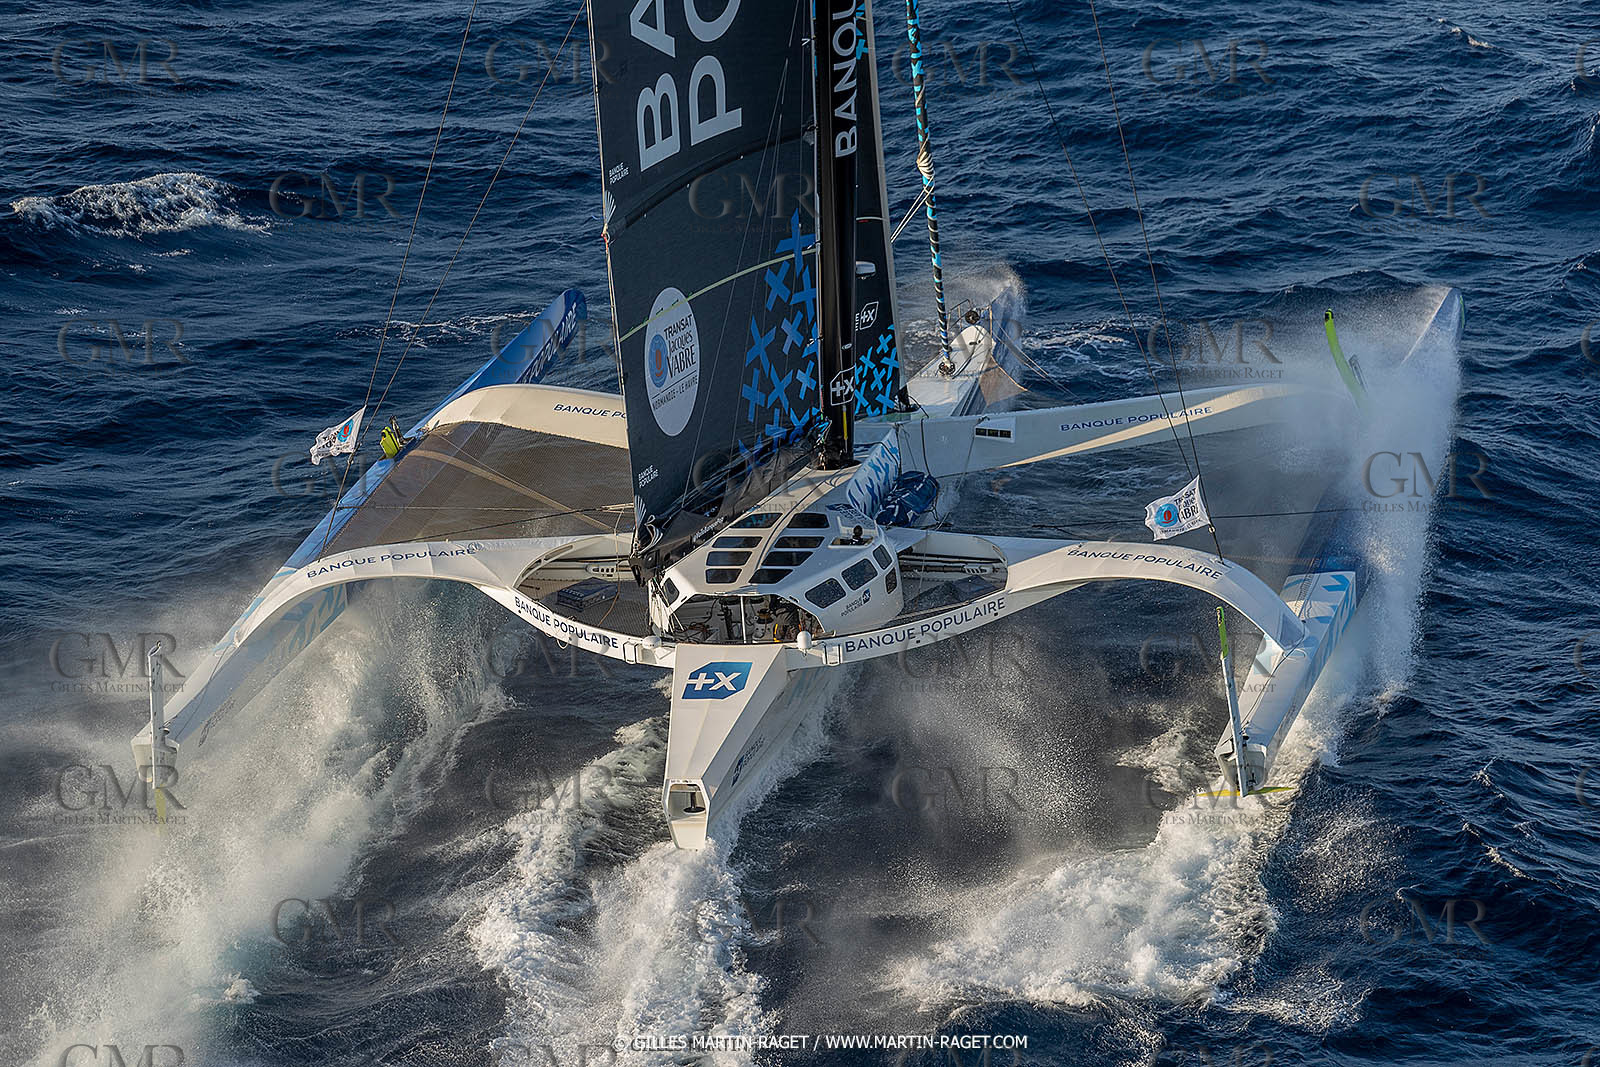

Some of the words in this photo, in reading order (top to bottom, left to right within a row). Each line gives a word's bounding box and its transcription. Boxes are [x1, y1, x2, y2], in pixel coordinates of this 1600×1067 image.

[663, 314, 692, 341] TRANSAT
[666, 344, 696, 379] VABRE
[553, 403, 611, 417] BANQUE
[1060, 417, 1123, 432] BANQUE
[1127, 406, 1213, 424] POPULAIRE
[306, 556, 377, 579] BANQUE
[380, 547, 476, 563] POPULAIRE
[1067, 549, 1133, 561] BANQUE
[1133, 554, 1223, 580] POPULAIRE
[514, 596, 552, 626] BANQUE
[553, 618, 619, 649] POPULAIRE
[845, 627, 917, 653] BANQUE
[920, 597, 1006, 637] POPULAIRE
